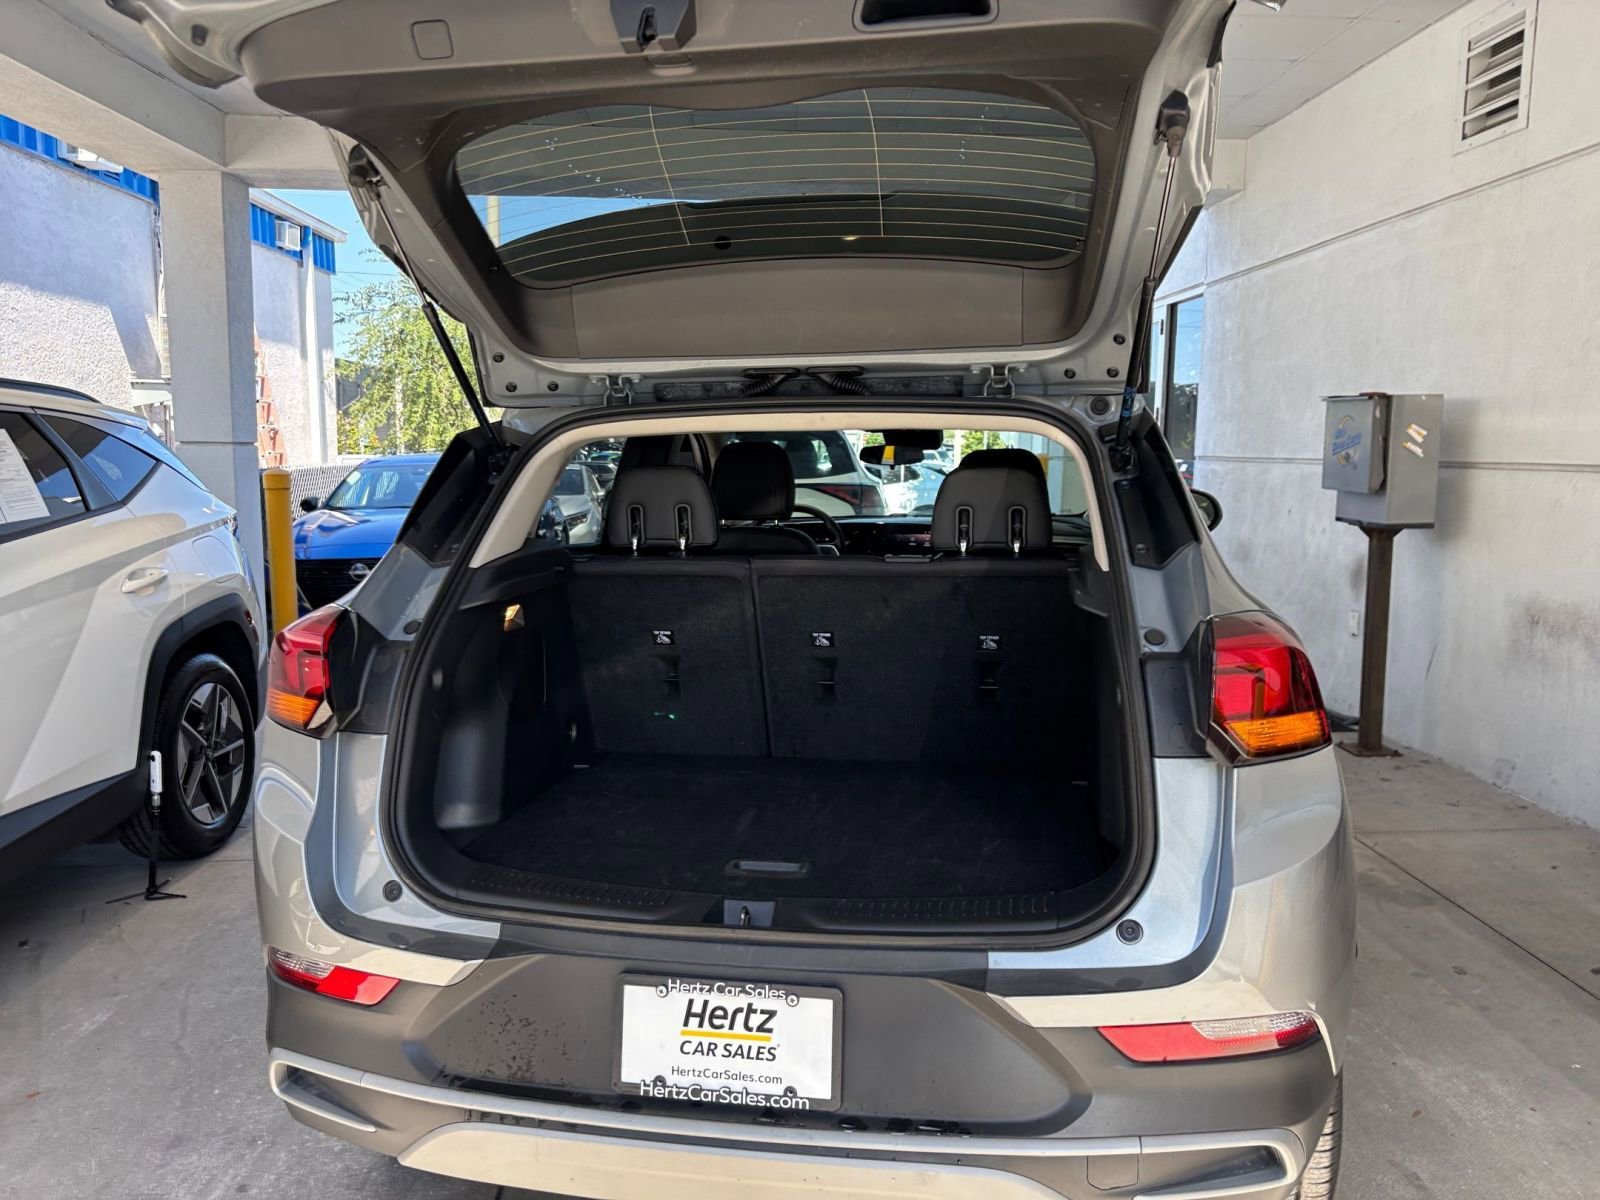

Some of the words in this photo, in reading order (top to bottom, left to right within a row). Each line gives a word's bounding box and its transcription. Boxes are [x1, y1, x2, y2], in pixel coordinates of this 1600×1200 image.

[668, 979, 711, 995] Hertz
[714, 982, 742, 997] Car
[745, 984, 786, 1000] Sales
[682, 998, 778, 1034] Hertz
[680, 1040, 718, 1057] CAR
[721, 1043, 777, 1062] SALES
[671, 1066, 783, 1085] HertzCarSales.com
[640, 1080, 810, 1110] HertzCarSales.com
